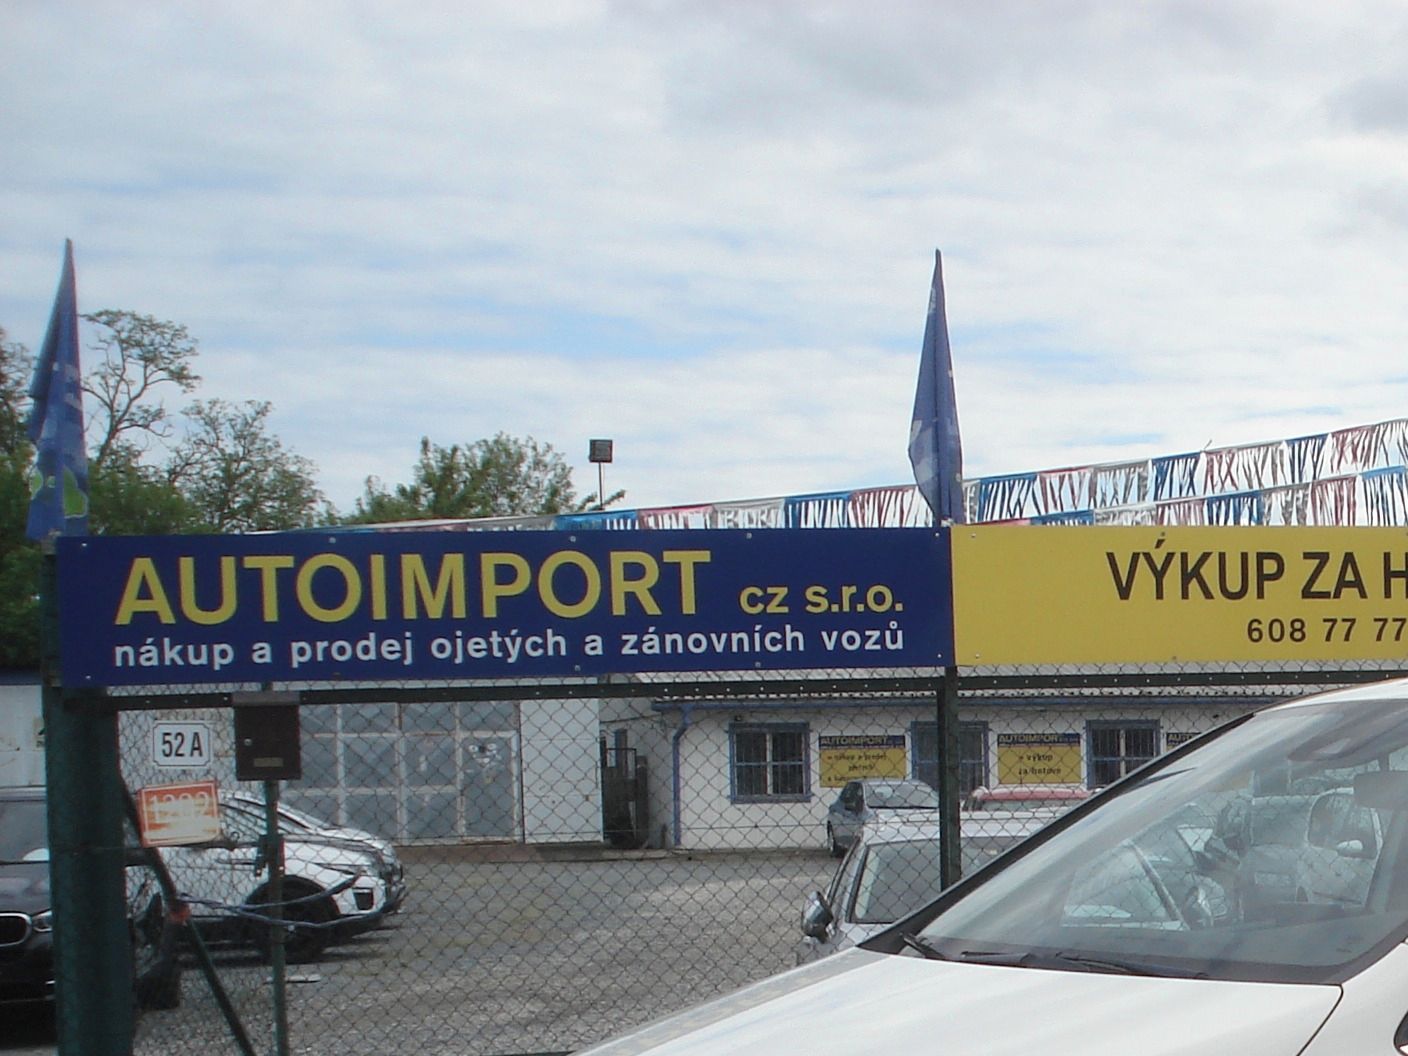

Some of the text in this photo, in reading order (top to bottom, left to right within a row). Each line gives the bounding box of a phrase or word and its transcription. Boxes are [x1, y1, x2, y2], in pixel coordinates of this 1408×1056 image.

[114, 549, 903, 626] AUTOIMPORT cz s.r.o.
[1106, 538, 1285, 600] VÝKUP
[1301, 551, 1367, 600] ZA
[114, 620, 903, 670] nákup a prodej ojetých a zánovních vozů
[1247, 618, 1307, 643] 608
[1322, 618, 1357, 642] 77
[1373, 618, 1408, 642] 77
[162, 732, 203, 758] 52 A
